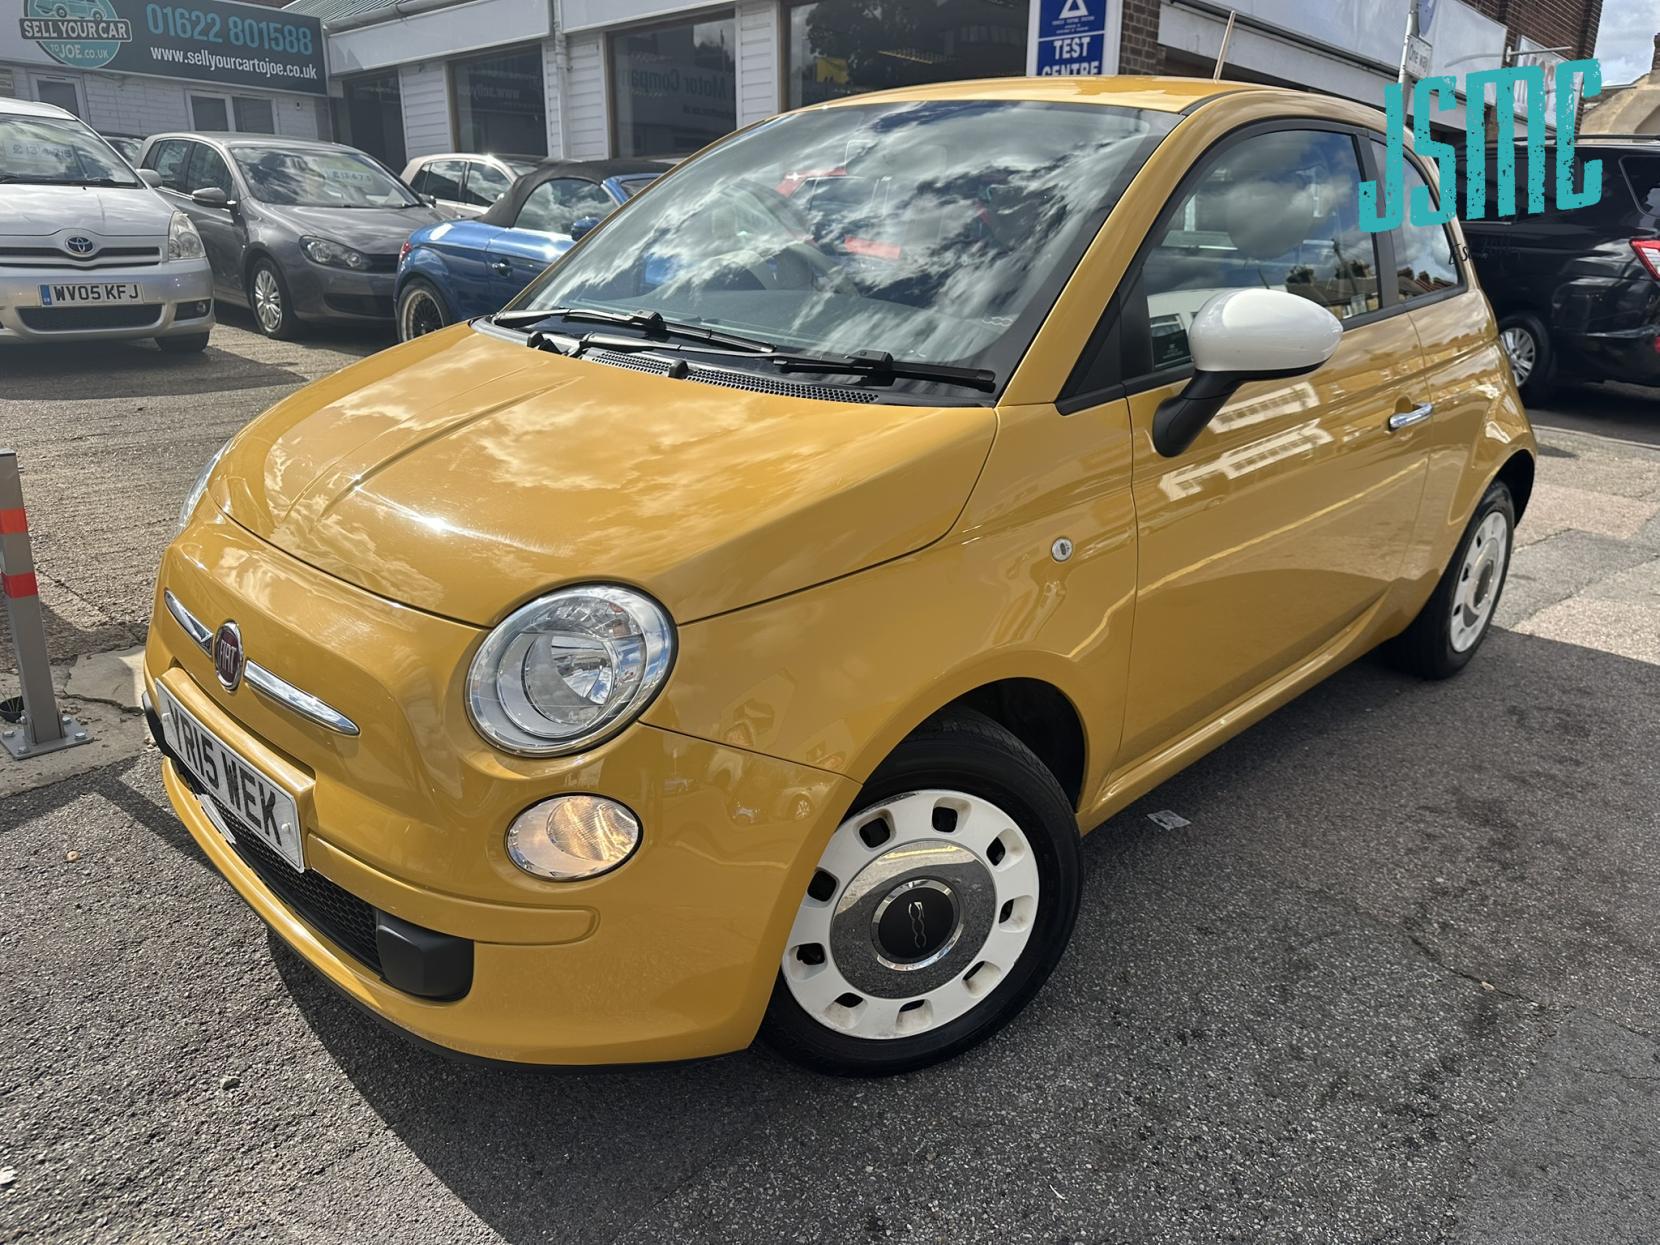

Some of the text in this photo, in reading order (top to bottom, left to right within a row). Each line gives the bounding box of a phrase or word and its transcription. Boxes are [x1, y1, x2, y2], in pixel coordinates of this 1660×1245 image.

[23, 20, 127, 39] SELL YOUR CAR
[146, 3, 313, 55] 01622 801588
[150, 46, 318, 80] www.sellyourcartojoe.co.uk
[1053, 36, 1091, 60] TEST
[53, 285, 101, 302] WV05
[104, 284, 139, 300] KFJ
[220, 639, 238, 674] FIAT
[168, 700, 283, 847] YR15 WEK
